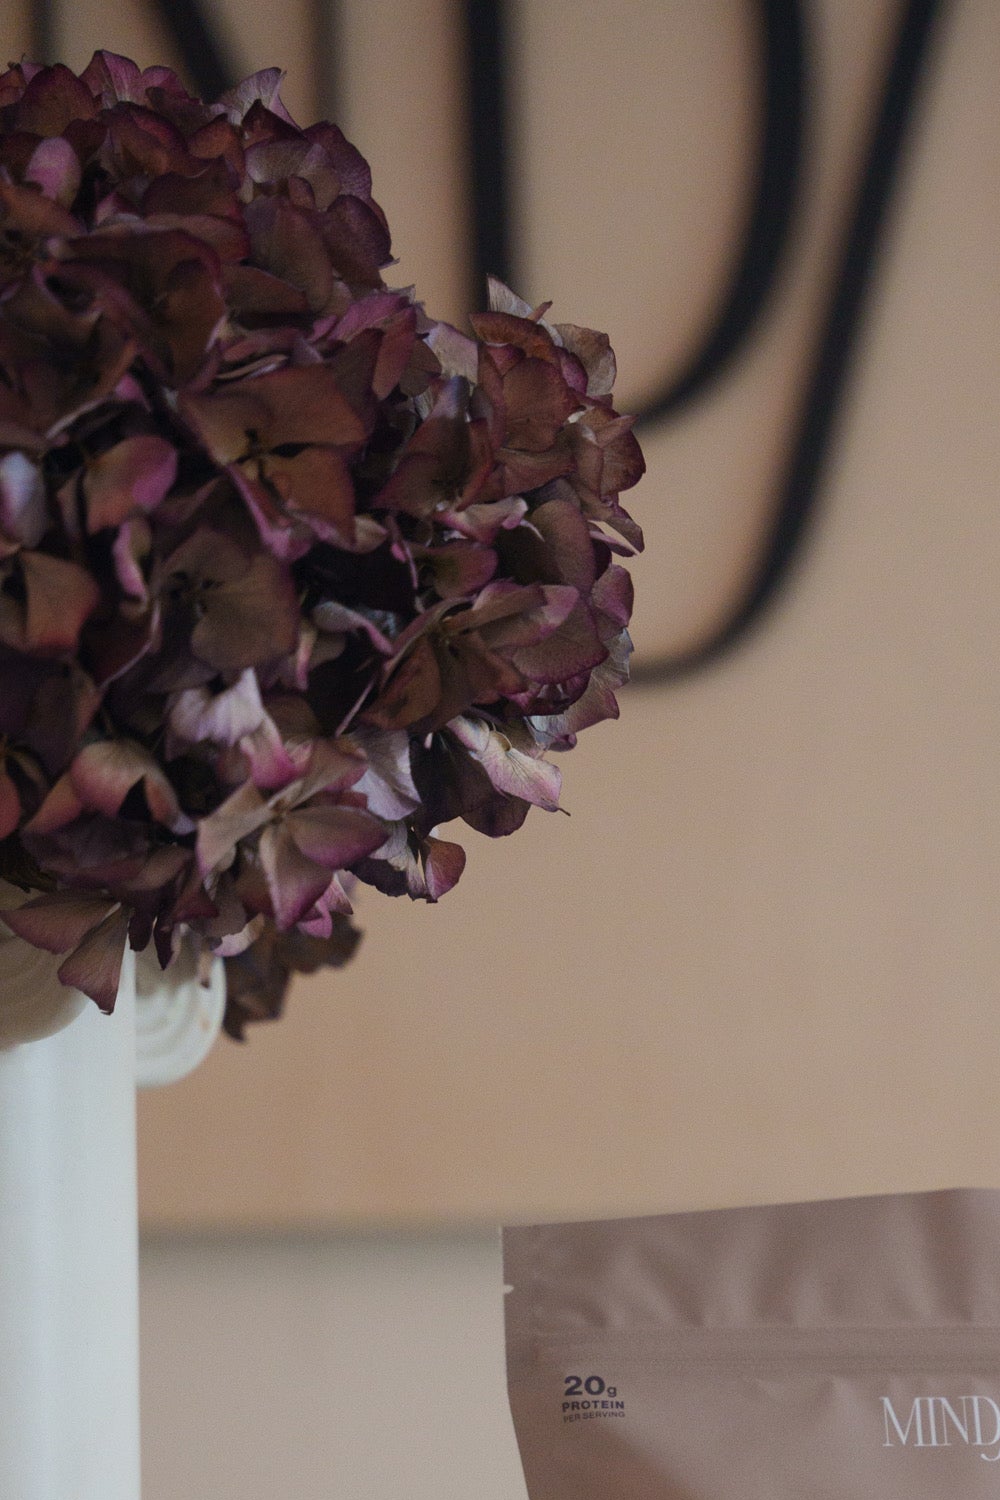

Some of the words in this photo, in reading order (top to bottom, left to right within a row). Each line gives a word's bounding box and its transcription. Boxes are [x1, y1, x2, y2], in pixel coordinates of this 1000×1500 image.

[563, 1375, 618, 1398] 20g
[561, 1400, 625, 1413] PROTEIN
[563, 1413, 580, 1424] PER
[582, 1410, 626, 1420] SERVING
